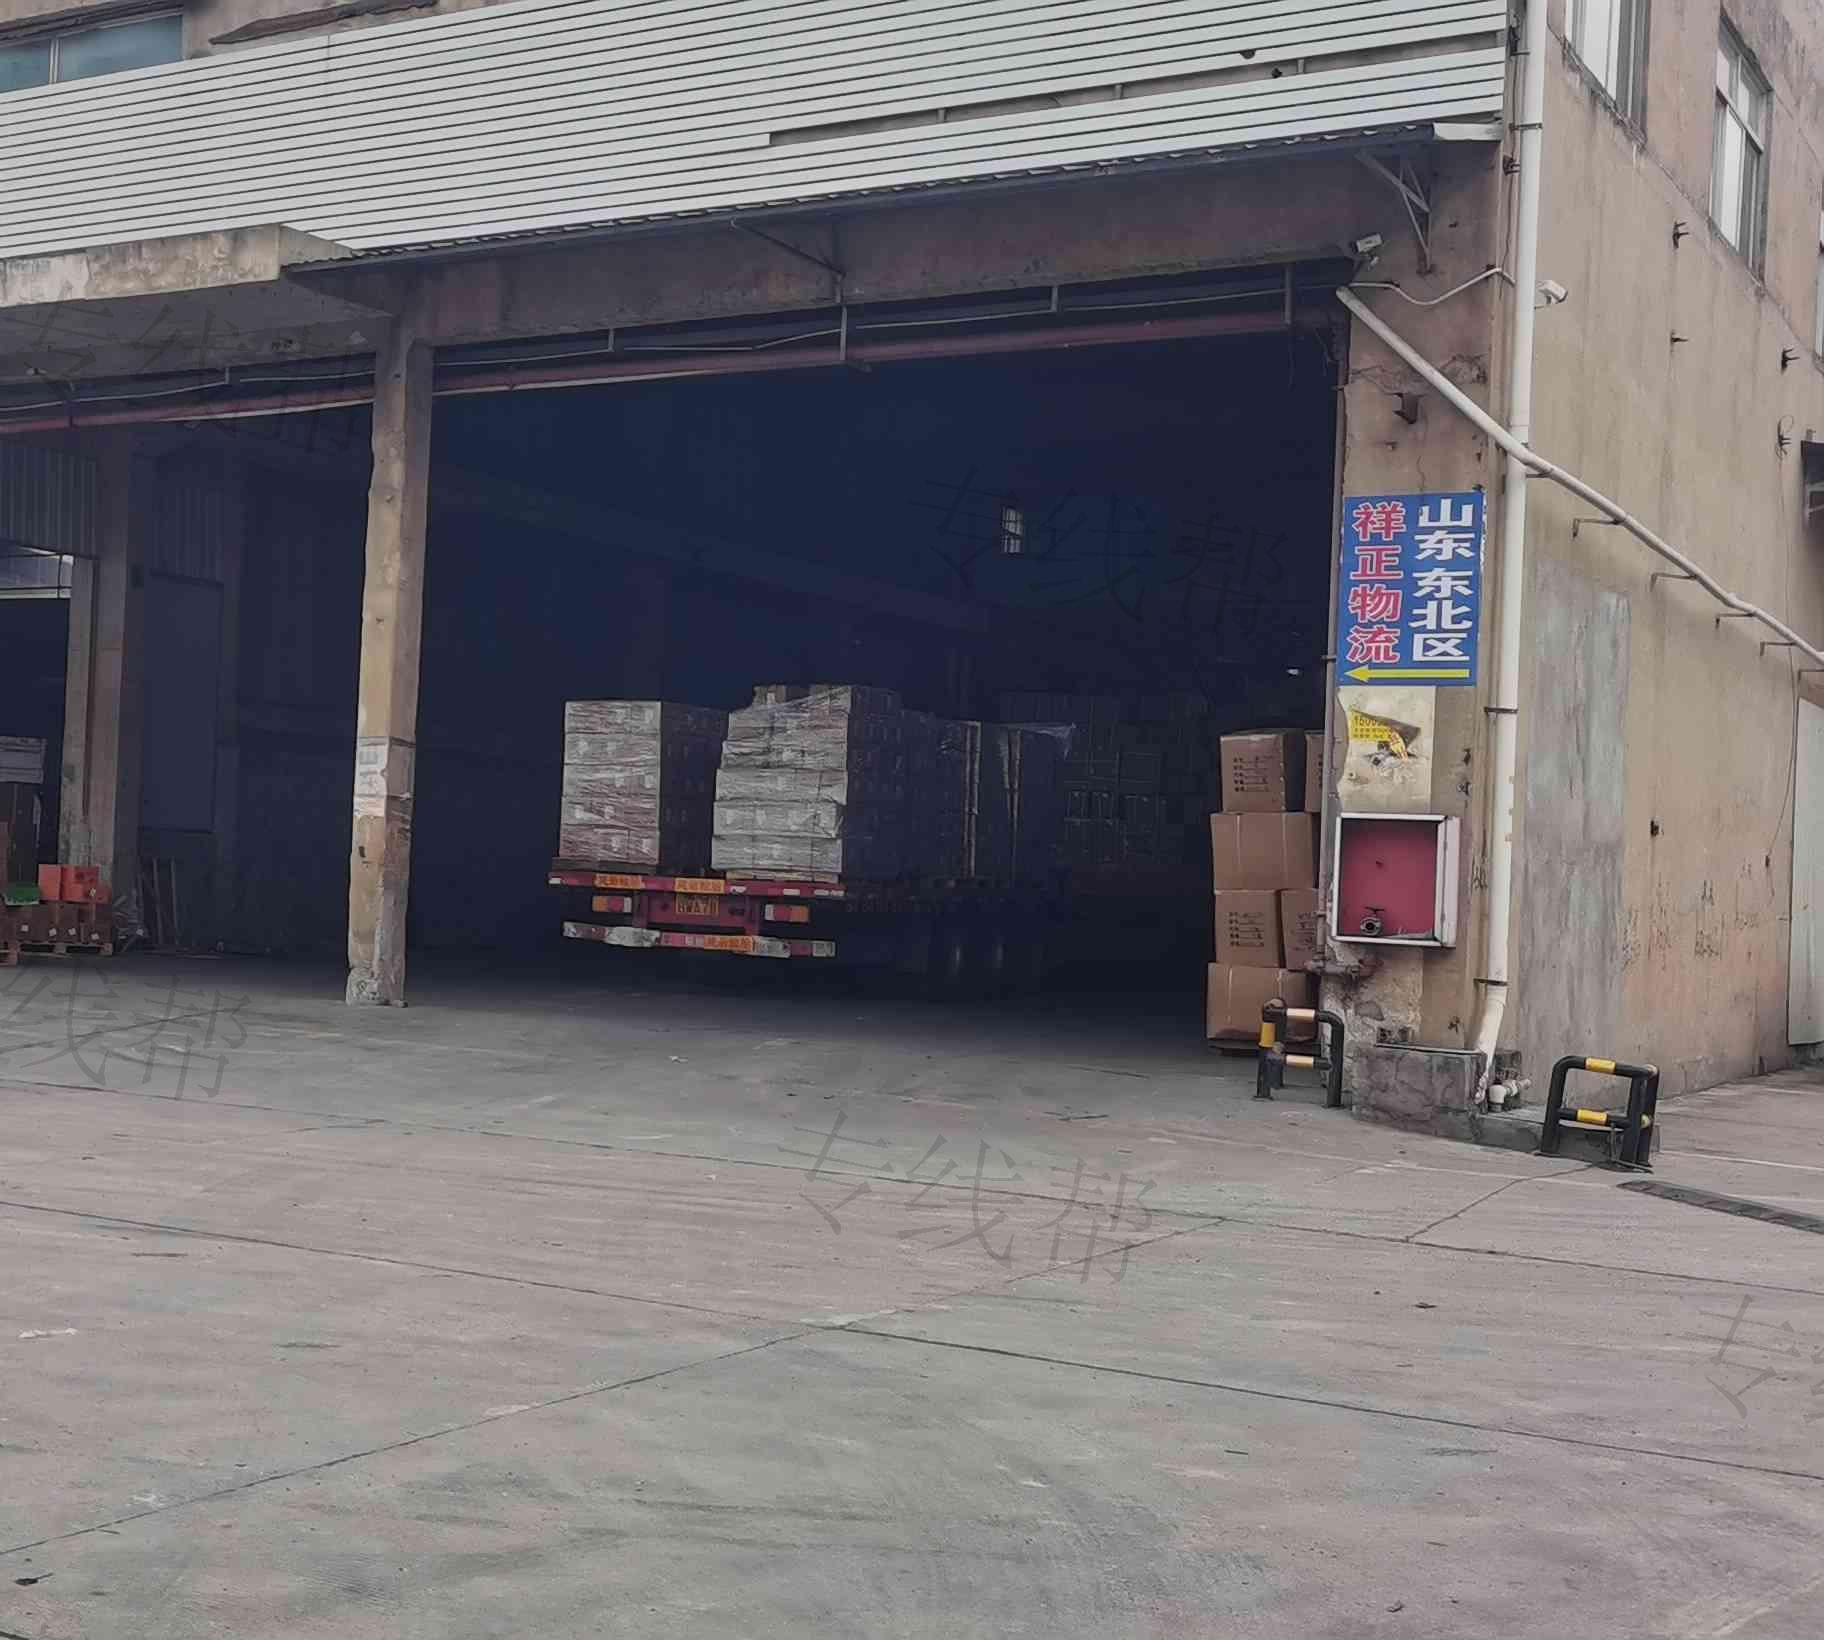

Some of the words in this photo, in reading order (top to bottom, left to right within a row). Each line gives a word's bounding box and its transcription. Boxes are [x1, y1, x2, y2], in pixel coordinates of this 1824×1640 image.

[1346, 501, 1407, 664] 祥正物流
[1408, 498, 1476, 662] 山东东北区
